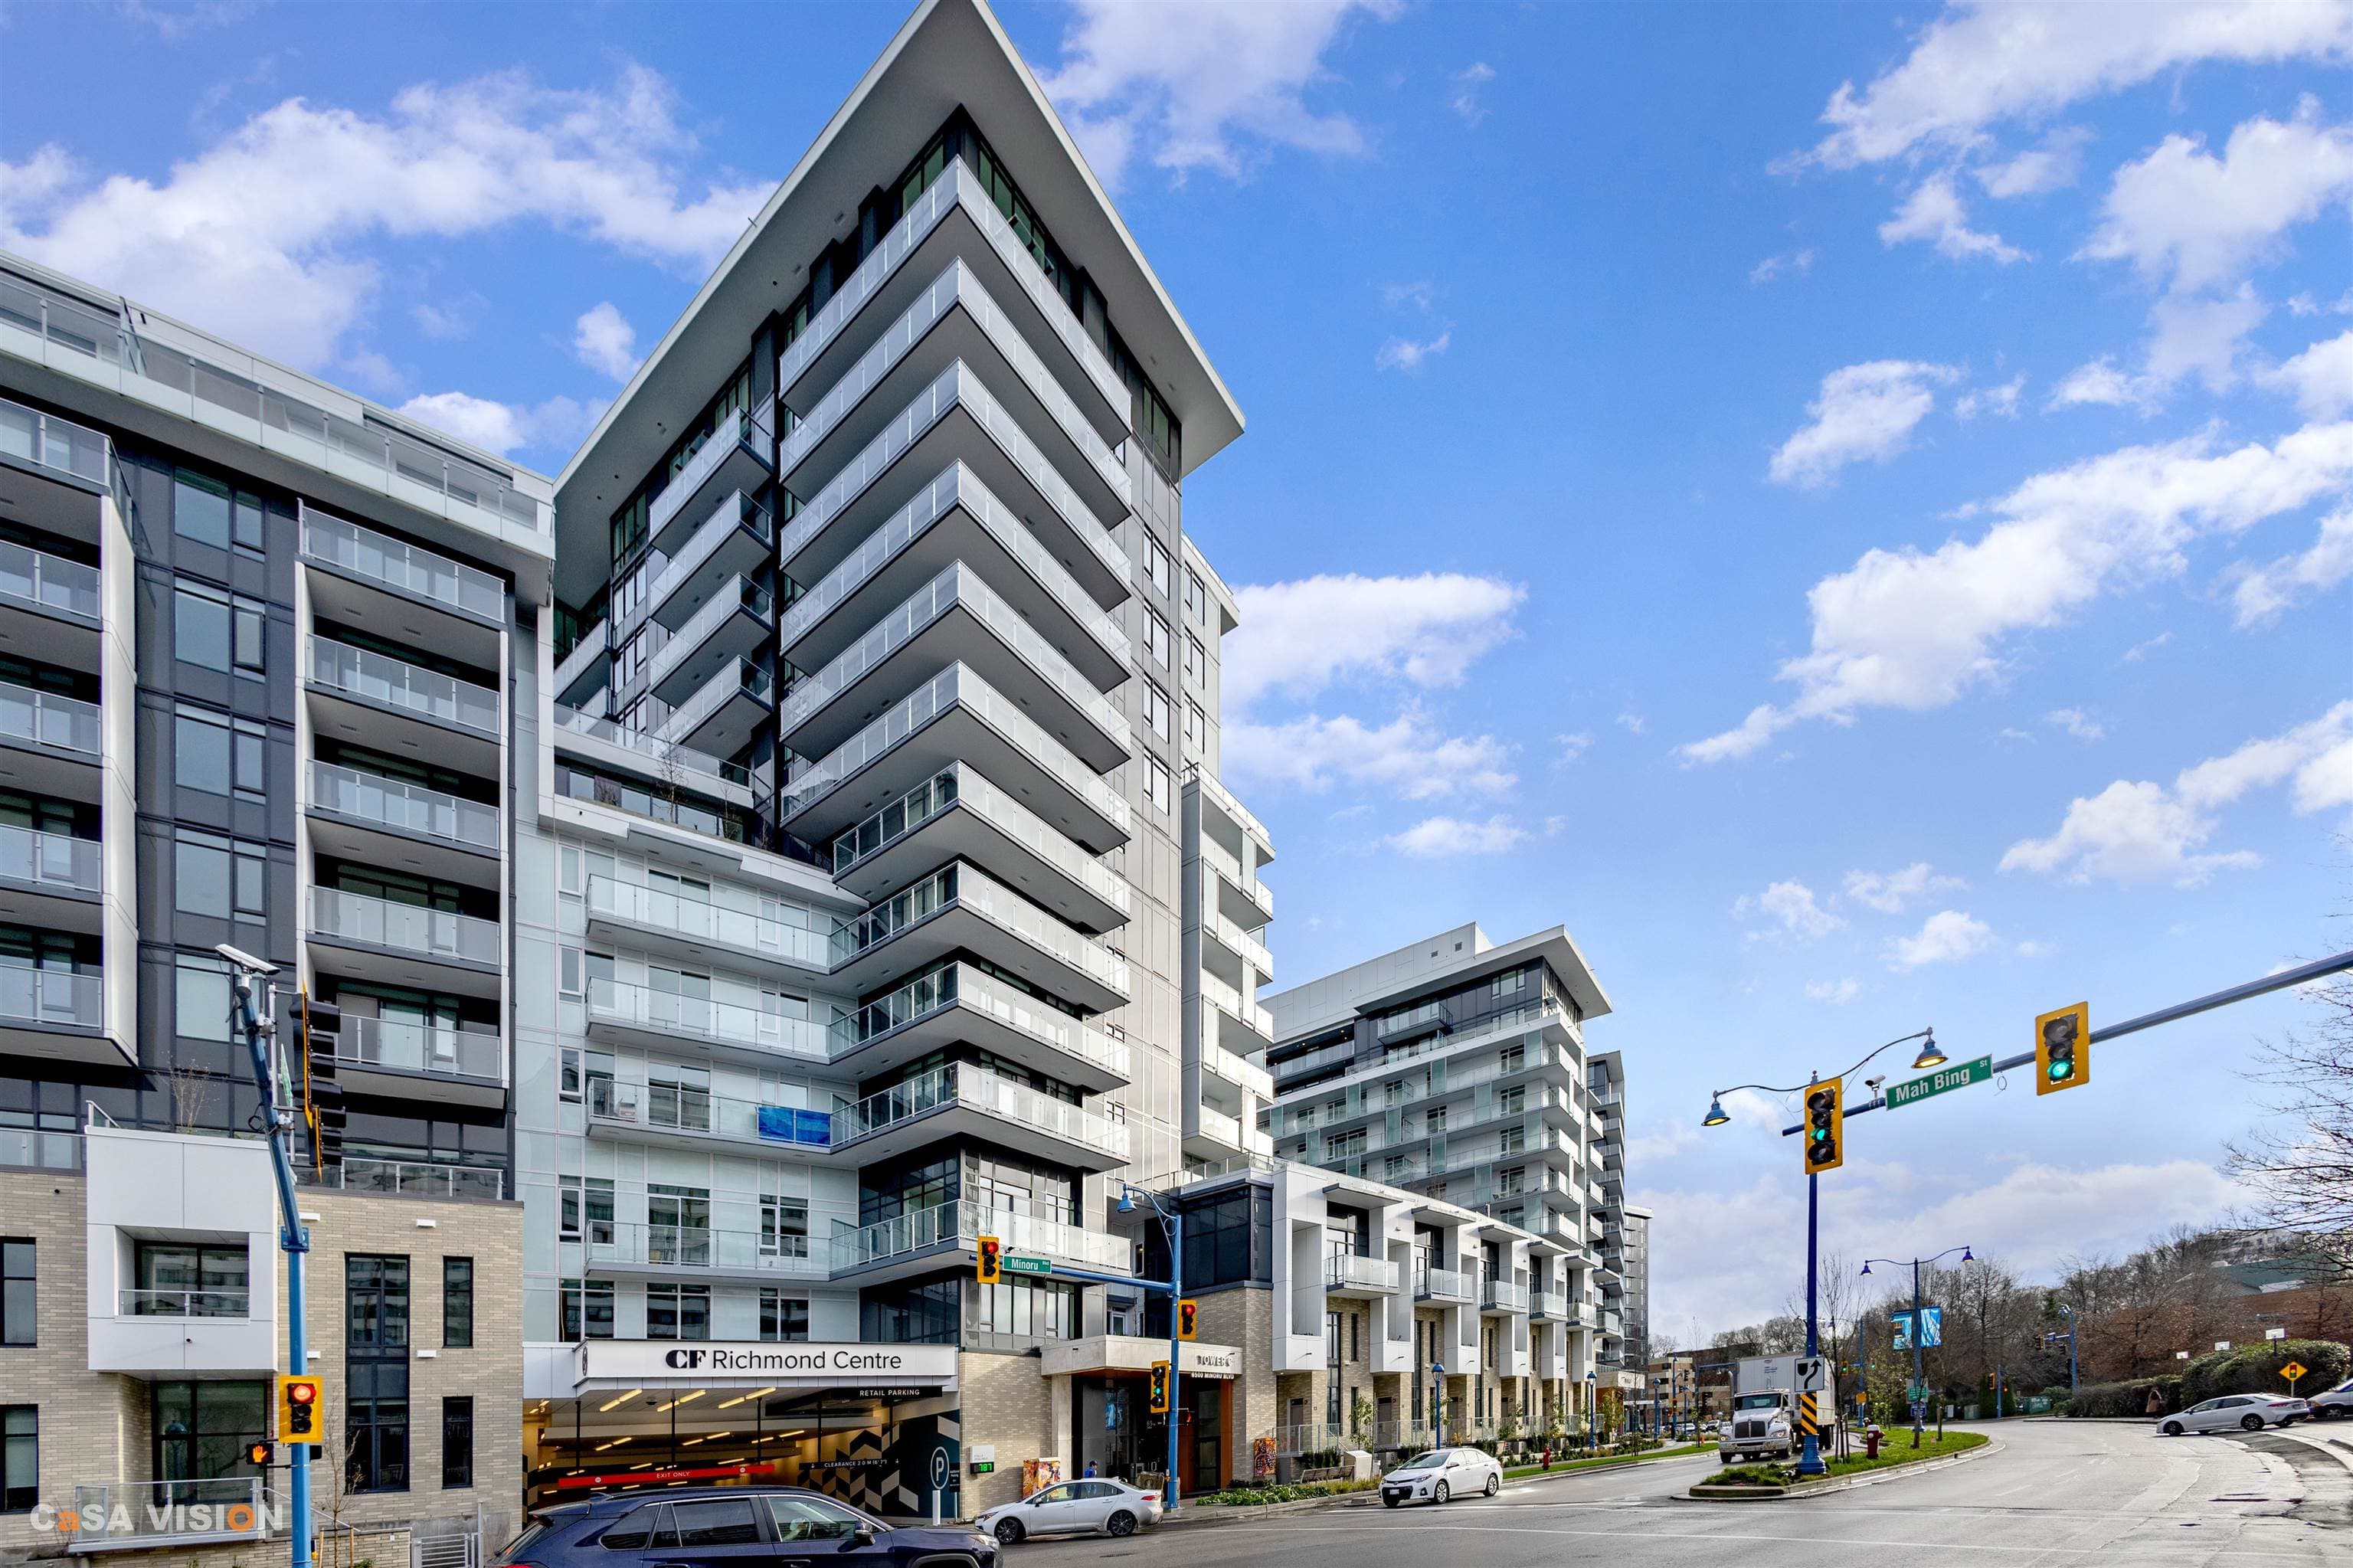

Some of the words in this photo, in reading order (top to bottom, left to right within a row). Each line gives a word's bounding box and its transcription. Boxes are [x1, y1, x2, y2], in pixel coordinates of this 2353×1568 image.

[1896, 1080, 1929, 1102] Mah
[1934, 1069, 1970, 1091] Bing
[1979, 1059, 1988, 1068] St
[1011, 1258, 1039, 1270] Minoru
[666, 1350, 706, 1369] CF
[713, 1350, 826, 1369] Richmond
[833, 1351, 902, 1369] Centre
[1199, 1354, 1226, 1366] TOWER
[978, 1463, 992, 1471] 787
